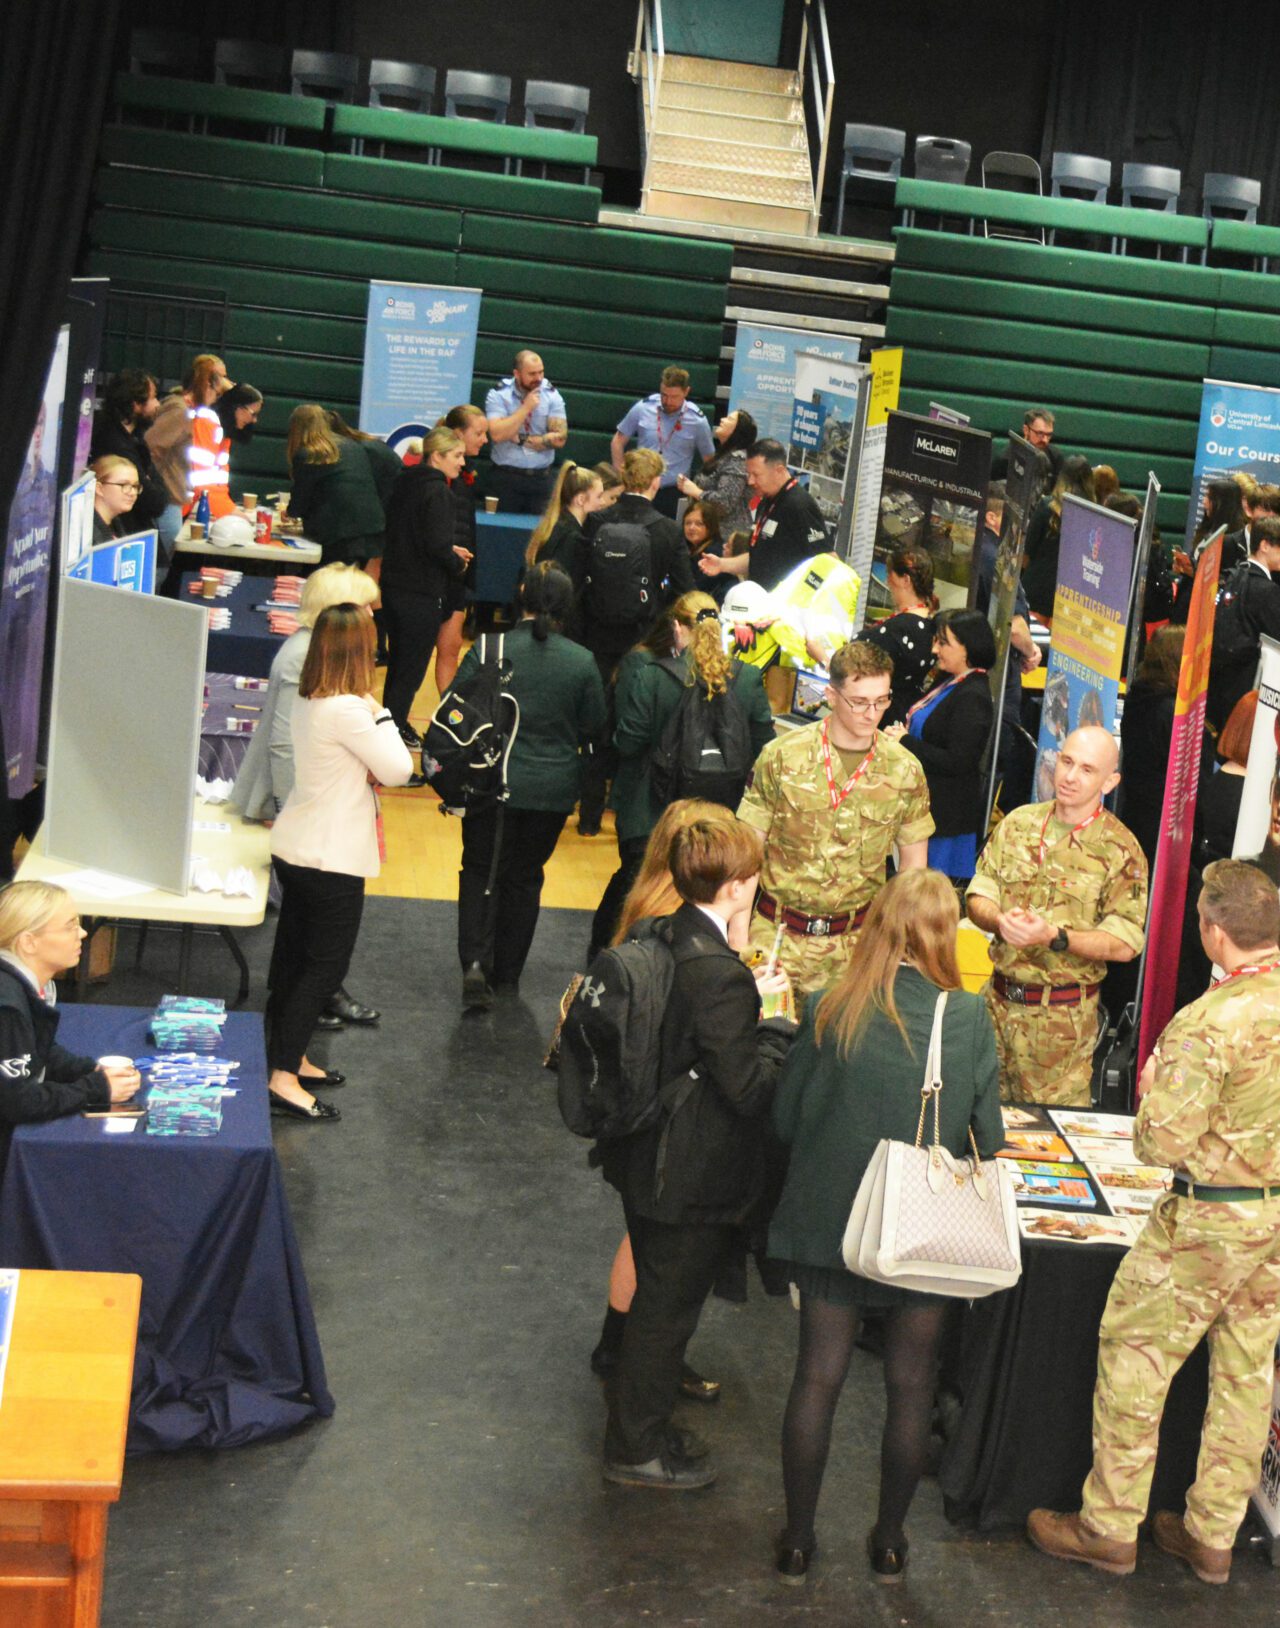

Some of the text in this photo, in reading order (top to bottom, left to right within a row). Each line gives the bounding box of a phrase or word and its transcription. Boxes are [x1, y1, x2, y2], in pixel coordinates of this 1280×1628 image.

[386, 334, 461, 346] THE REWARDS OF
[389, 345, 456, 357] LIFE IN THE RAF
[1228, 417, 1253, 427] Central
[1229, 409, 1272, 422] University of
[916, 437, 957, 457] McLAREN
[1206, 441, 1234, 457] Our
[885, 467, 938, 488] MANUFACTURING
[945, 480, 982, 499] INDUSTRIAL
[1052, 651, 1105, 690] ENGINEERING
